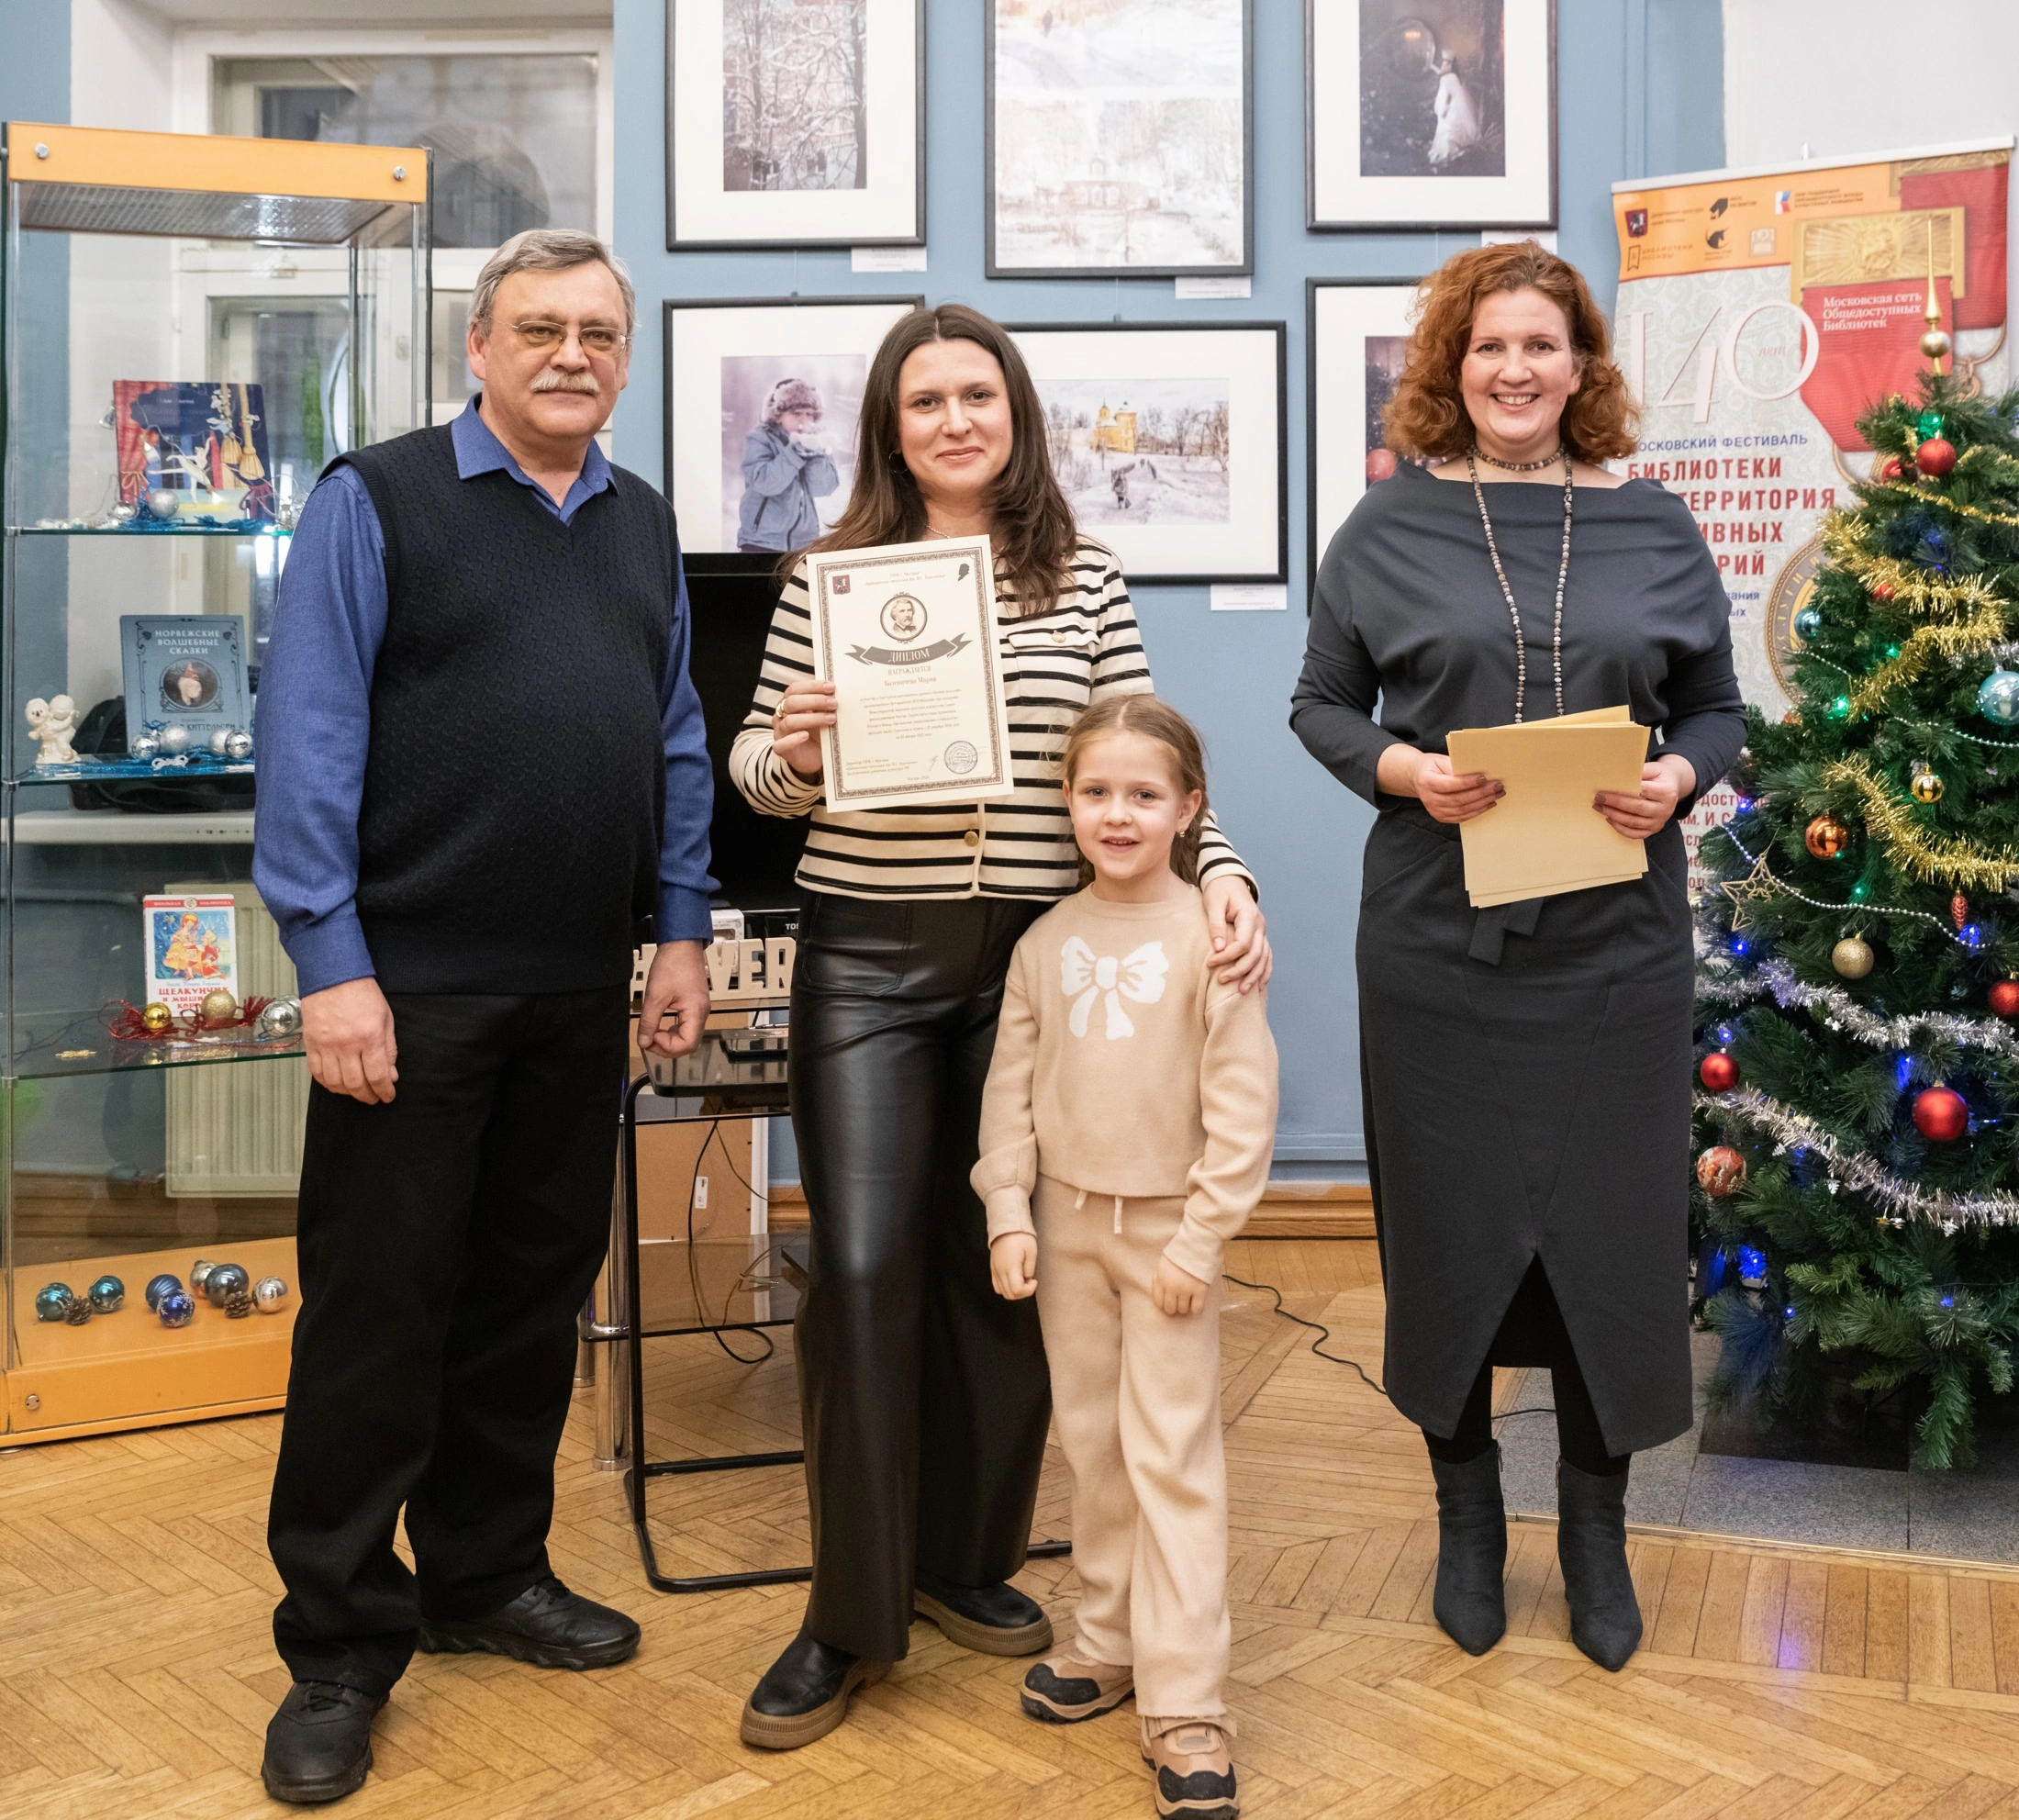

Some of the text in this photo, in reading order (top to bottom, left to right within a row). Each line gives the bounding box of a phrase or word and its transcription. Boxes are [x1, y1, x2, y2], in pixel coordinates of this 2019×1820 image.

[1824, 292, 1923, 308] Московская сеть
[1823, 304, 1922, 319] Общедоступных
[1823, 318, 1887, 331] Библиотек
[1624, 300, 1820, 423] 140
[1637, 434, 1808, 452] ОСКОВСКИЙ ФЕСТИВАЛЬ
[1627, 457, 1782, 482] БИБЛИОТЕКИ
[155, 630, 220, 638] НОРВЕЖСКИЕ
[887, 648, 931, 663] ДИПЛОМ
